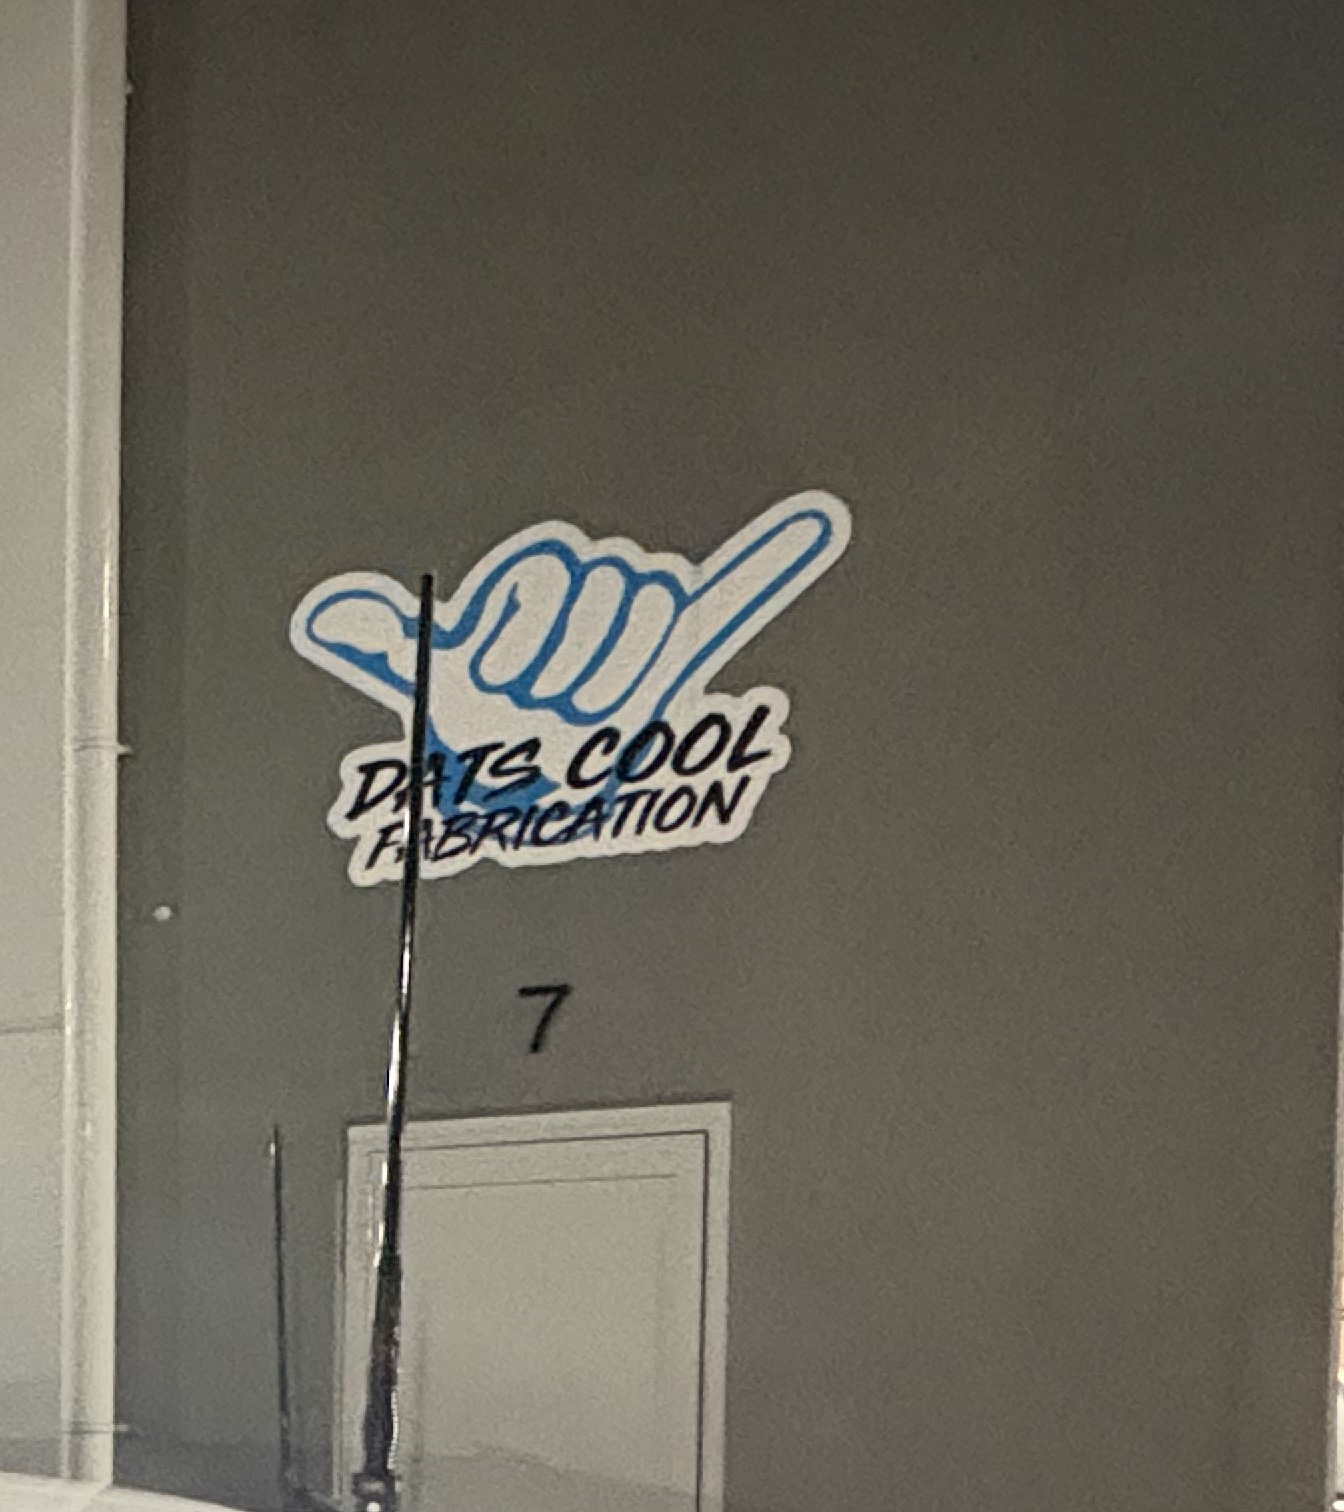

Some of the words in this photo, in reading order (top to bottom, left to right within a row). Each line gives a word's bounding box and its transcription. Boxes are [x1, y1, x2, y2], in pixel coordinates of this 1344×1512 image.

[346, 738, 542, 821] DATS
[566, 705, 772, 789] COOL
[365, 776, 751, 870] FABRICATION
[519, 984, 572, 1054] 7
